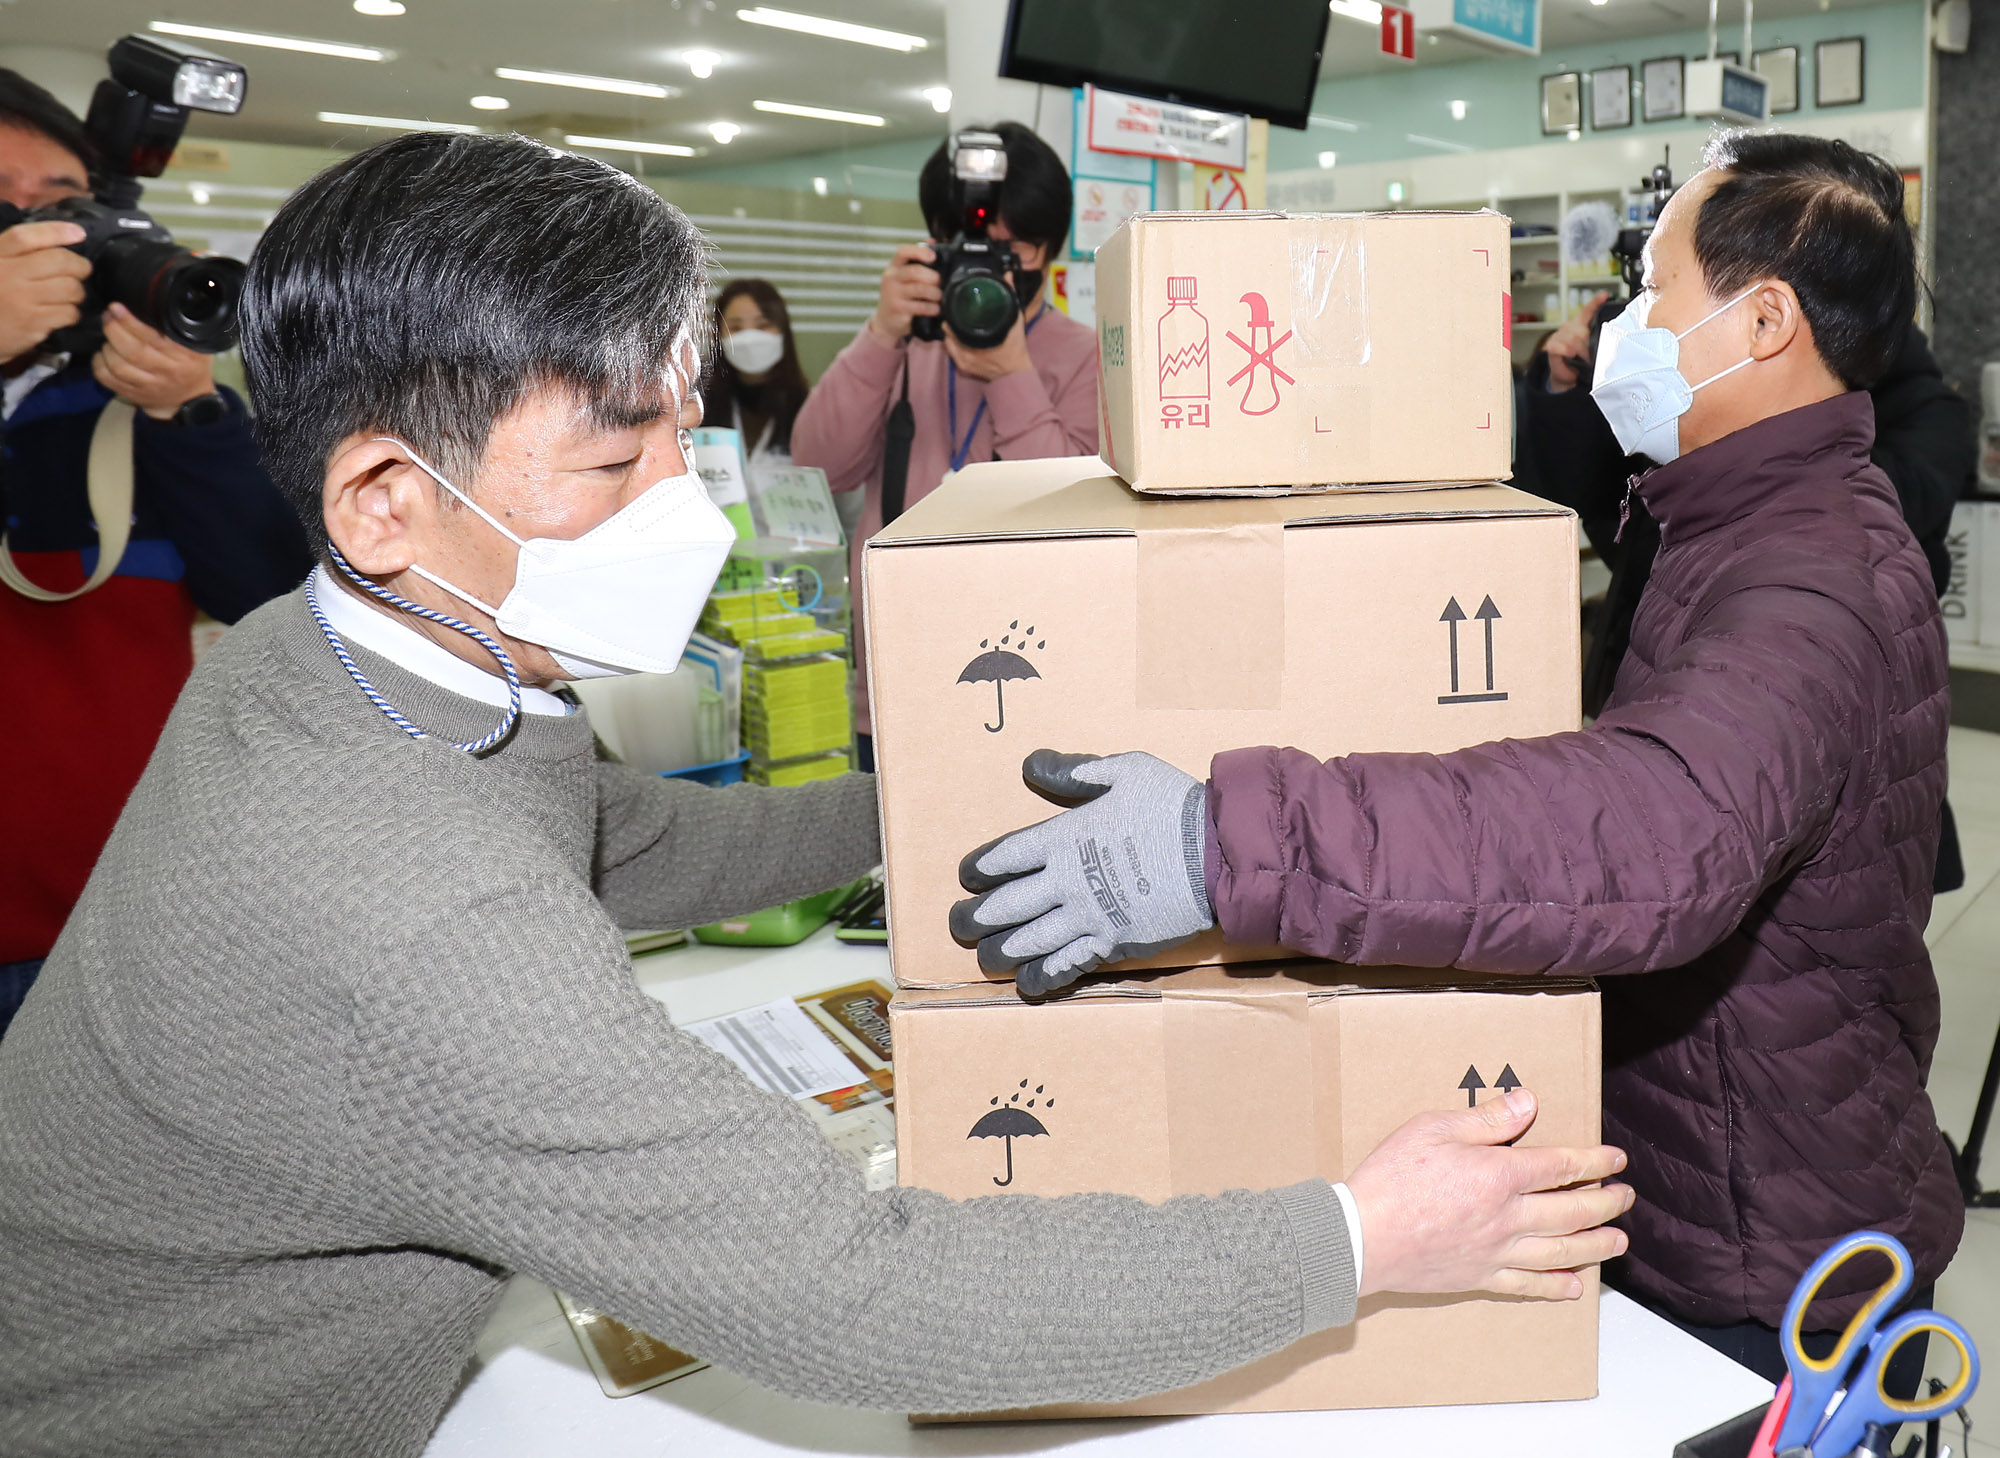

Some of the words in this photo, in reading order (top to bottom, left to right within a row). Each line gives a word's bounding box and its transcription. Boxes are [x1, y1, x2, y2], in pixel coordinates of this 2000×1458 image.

[1389, 12, 1404, 55] 1
[1160, 403, 1210, 429] 유리
[1108, 867, 1121, 889] Cool
